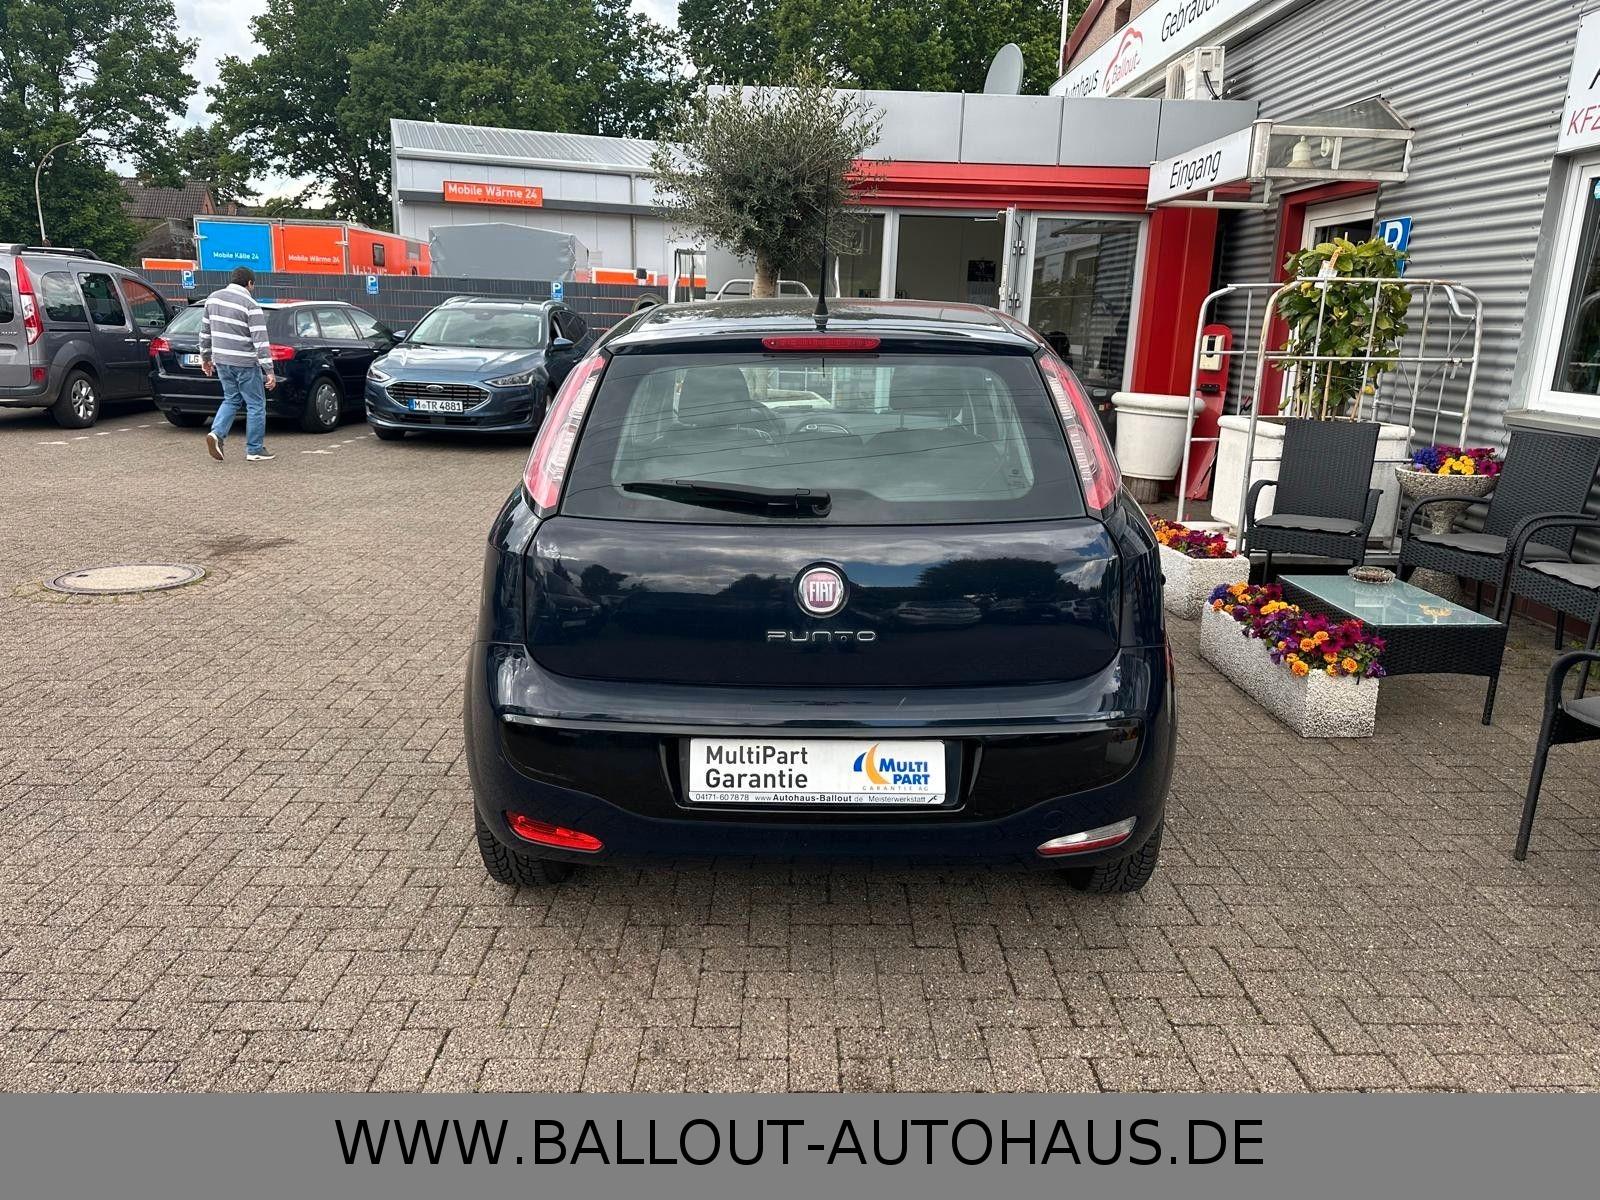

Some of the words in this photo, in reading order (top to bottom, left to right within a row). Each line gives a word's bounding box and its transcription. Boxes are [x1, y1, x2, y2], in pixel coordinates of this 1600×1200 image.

[1161, 0, 1221, 42] Gebrauc
[1112, 51, 1141, 85] Ballout
[1169, 150, 1222, 190] Eingang
[448, 184, 482, 196] Mobile
[486, 186, 522, 198] Wärme
[525, 189, 537, 199] 24
[213, 251, 233, 259] Mobile
[288, 254, 308, 262] Mobile
[183, 270, 192, 281] P
[367, 275, 377, 287] P
[552, 282, 561, 293] P
[188, 355, 199, 364] LG
[414, 401, 421, 409] M
[426, 401, 438, 410] TR
[439, 402, 461, 411] 4881
[809, 581, 835, 602] FIAT
[767, 630, 877, 642] PUNTO
[706, 745, 808, 765] MultiPart
[705, 767, 808, 789] Garantie
[893, 774, 930, 785] PART
[868, 795, 926, 803] Meisterwerkstatt
